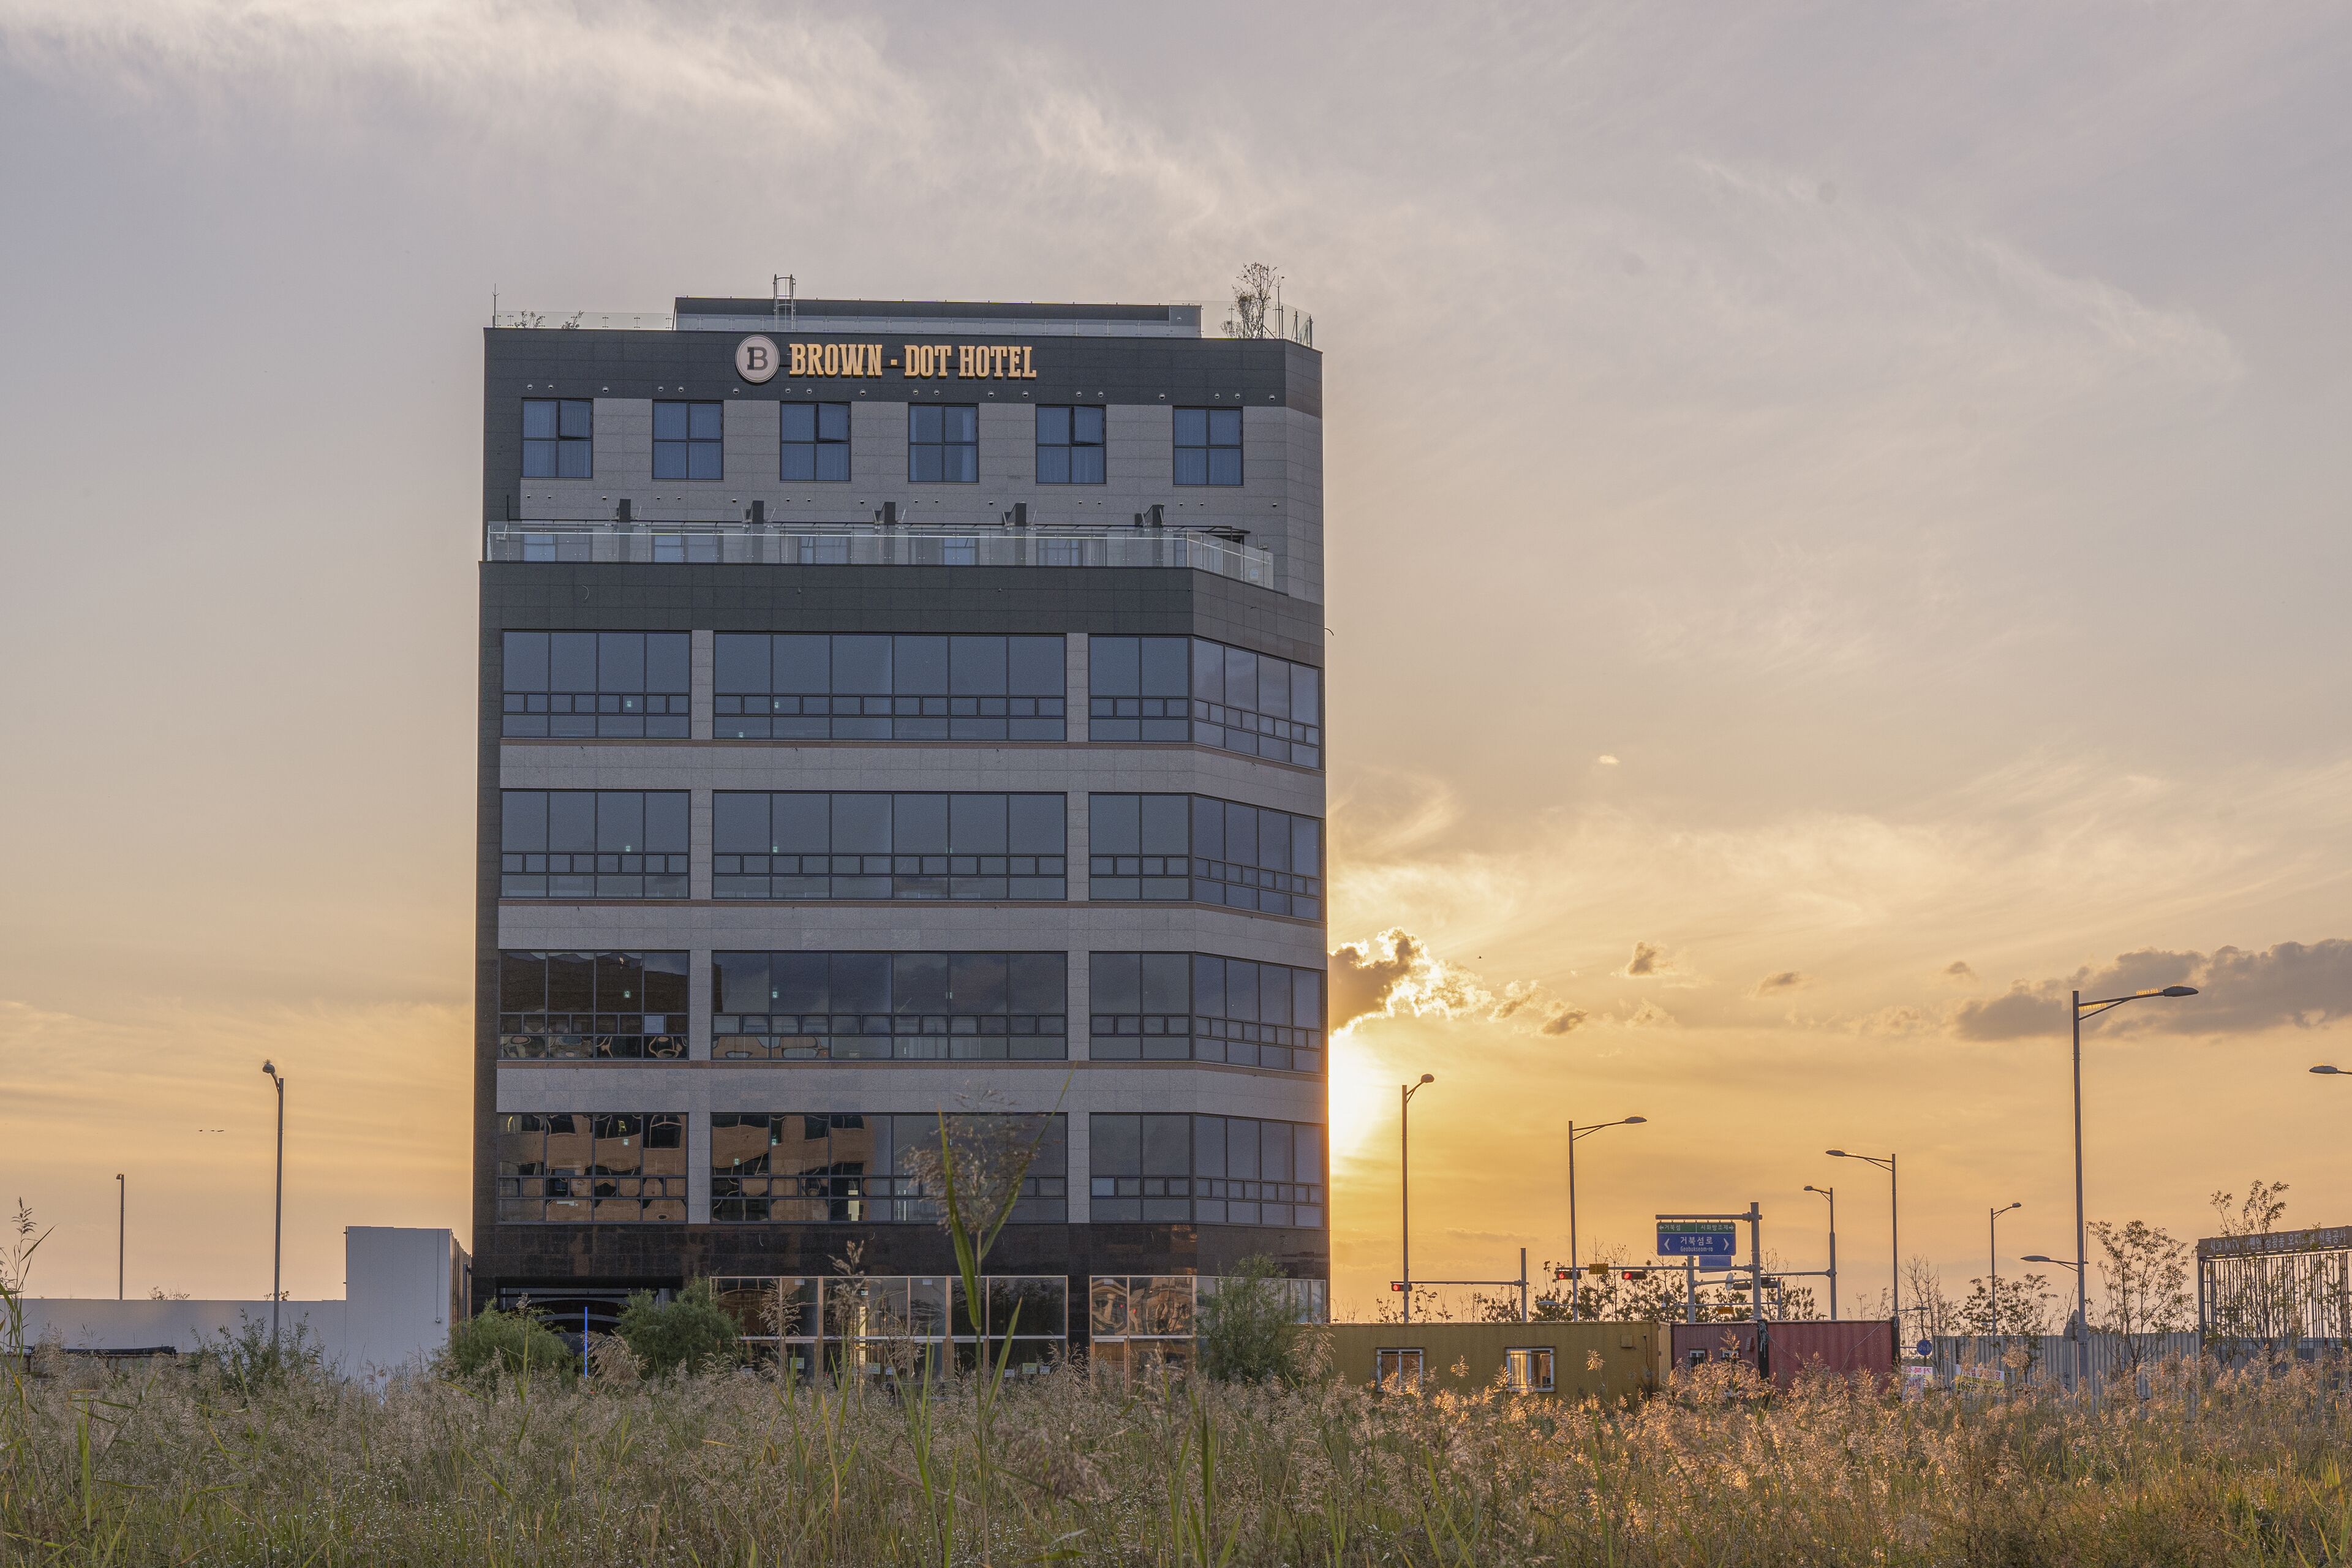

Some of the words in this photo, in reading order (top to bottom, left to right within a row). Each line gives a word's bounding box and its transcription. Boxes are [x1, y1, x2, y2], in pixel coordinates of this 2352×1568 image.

[789, 343, 883, 377] BROWN
[904, 345, 952, 378] DOT
[959, 345, 1037, 379] HOTEL
[1680, 1237, 1713, 1246] 거북섬로
[2318, 1229, 2346, 1245] 신축공사
